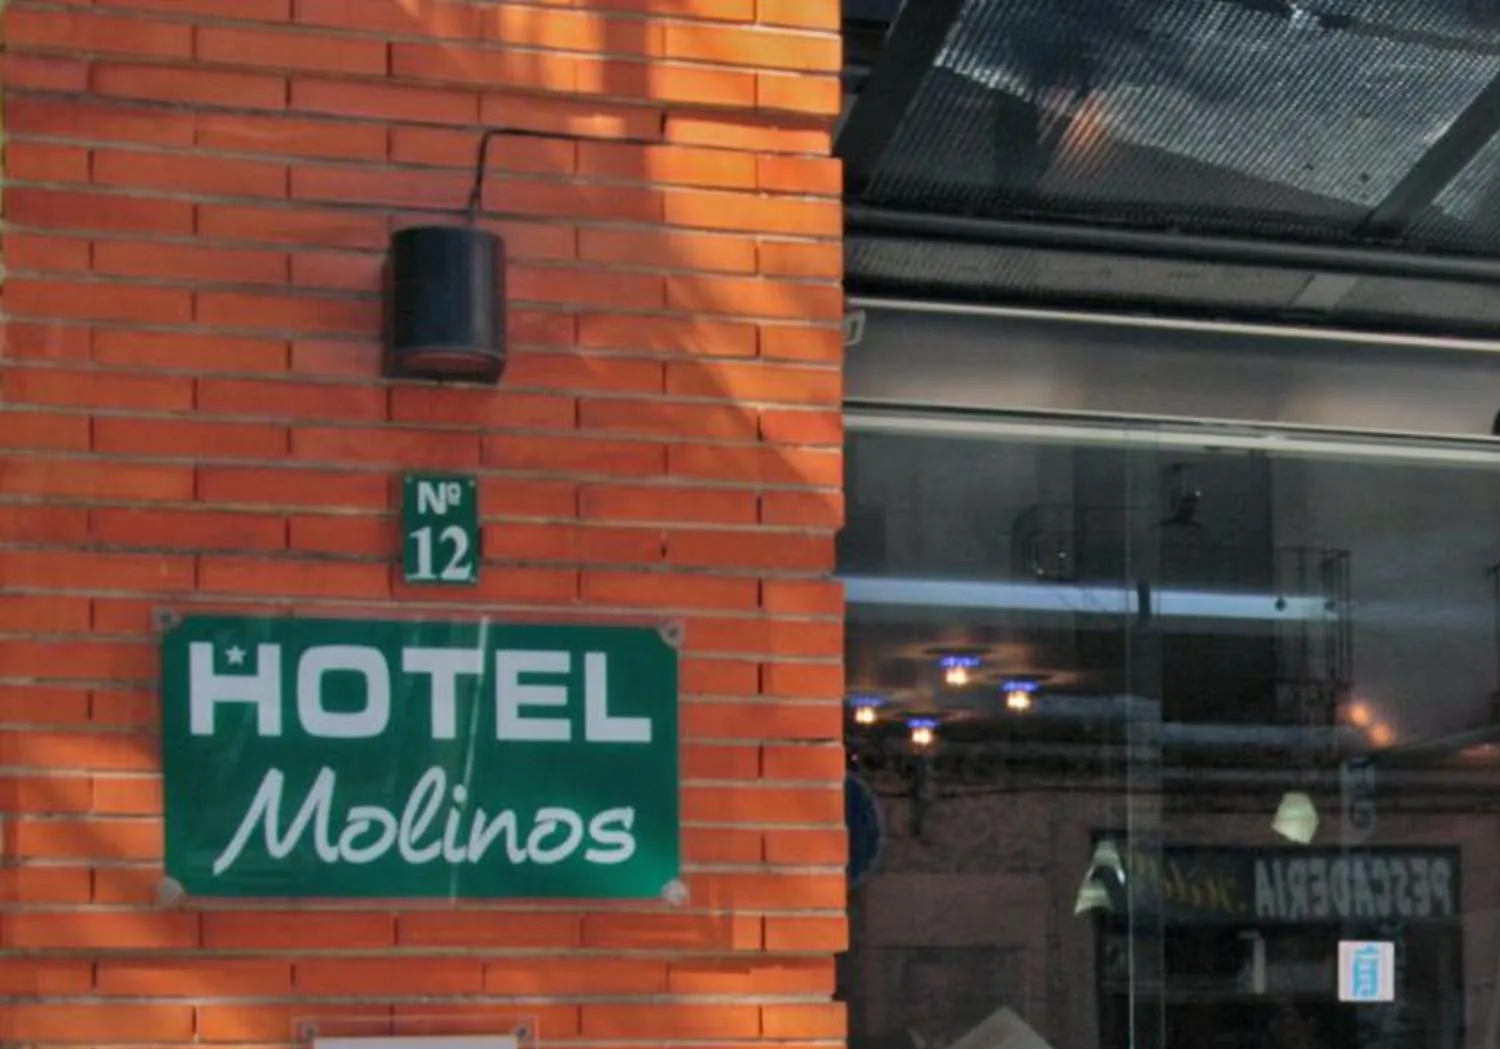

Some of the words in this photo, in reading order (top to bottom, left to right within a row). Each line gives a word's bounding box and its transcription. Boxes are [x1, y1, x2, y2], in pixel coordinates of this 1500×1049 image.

[408, 525, 472, 581] 12
[188, 641, 652, 743] HOTEL
[212, 766, 636, 876] Molinos
